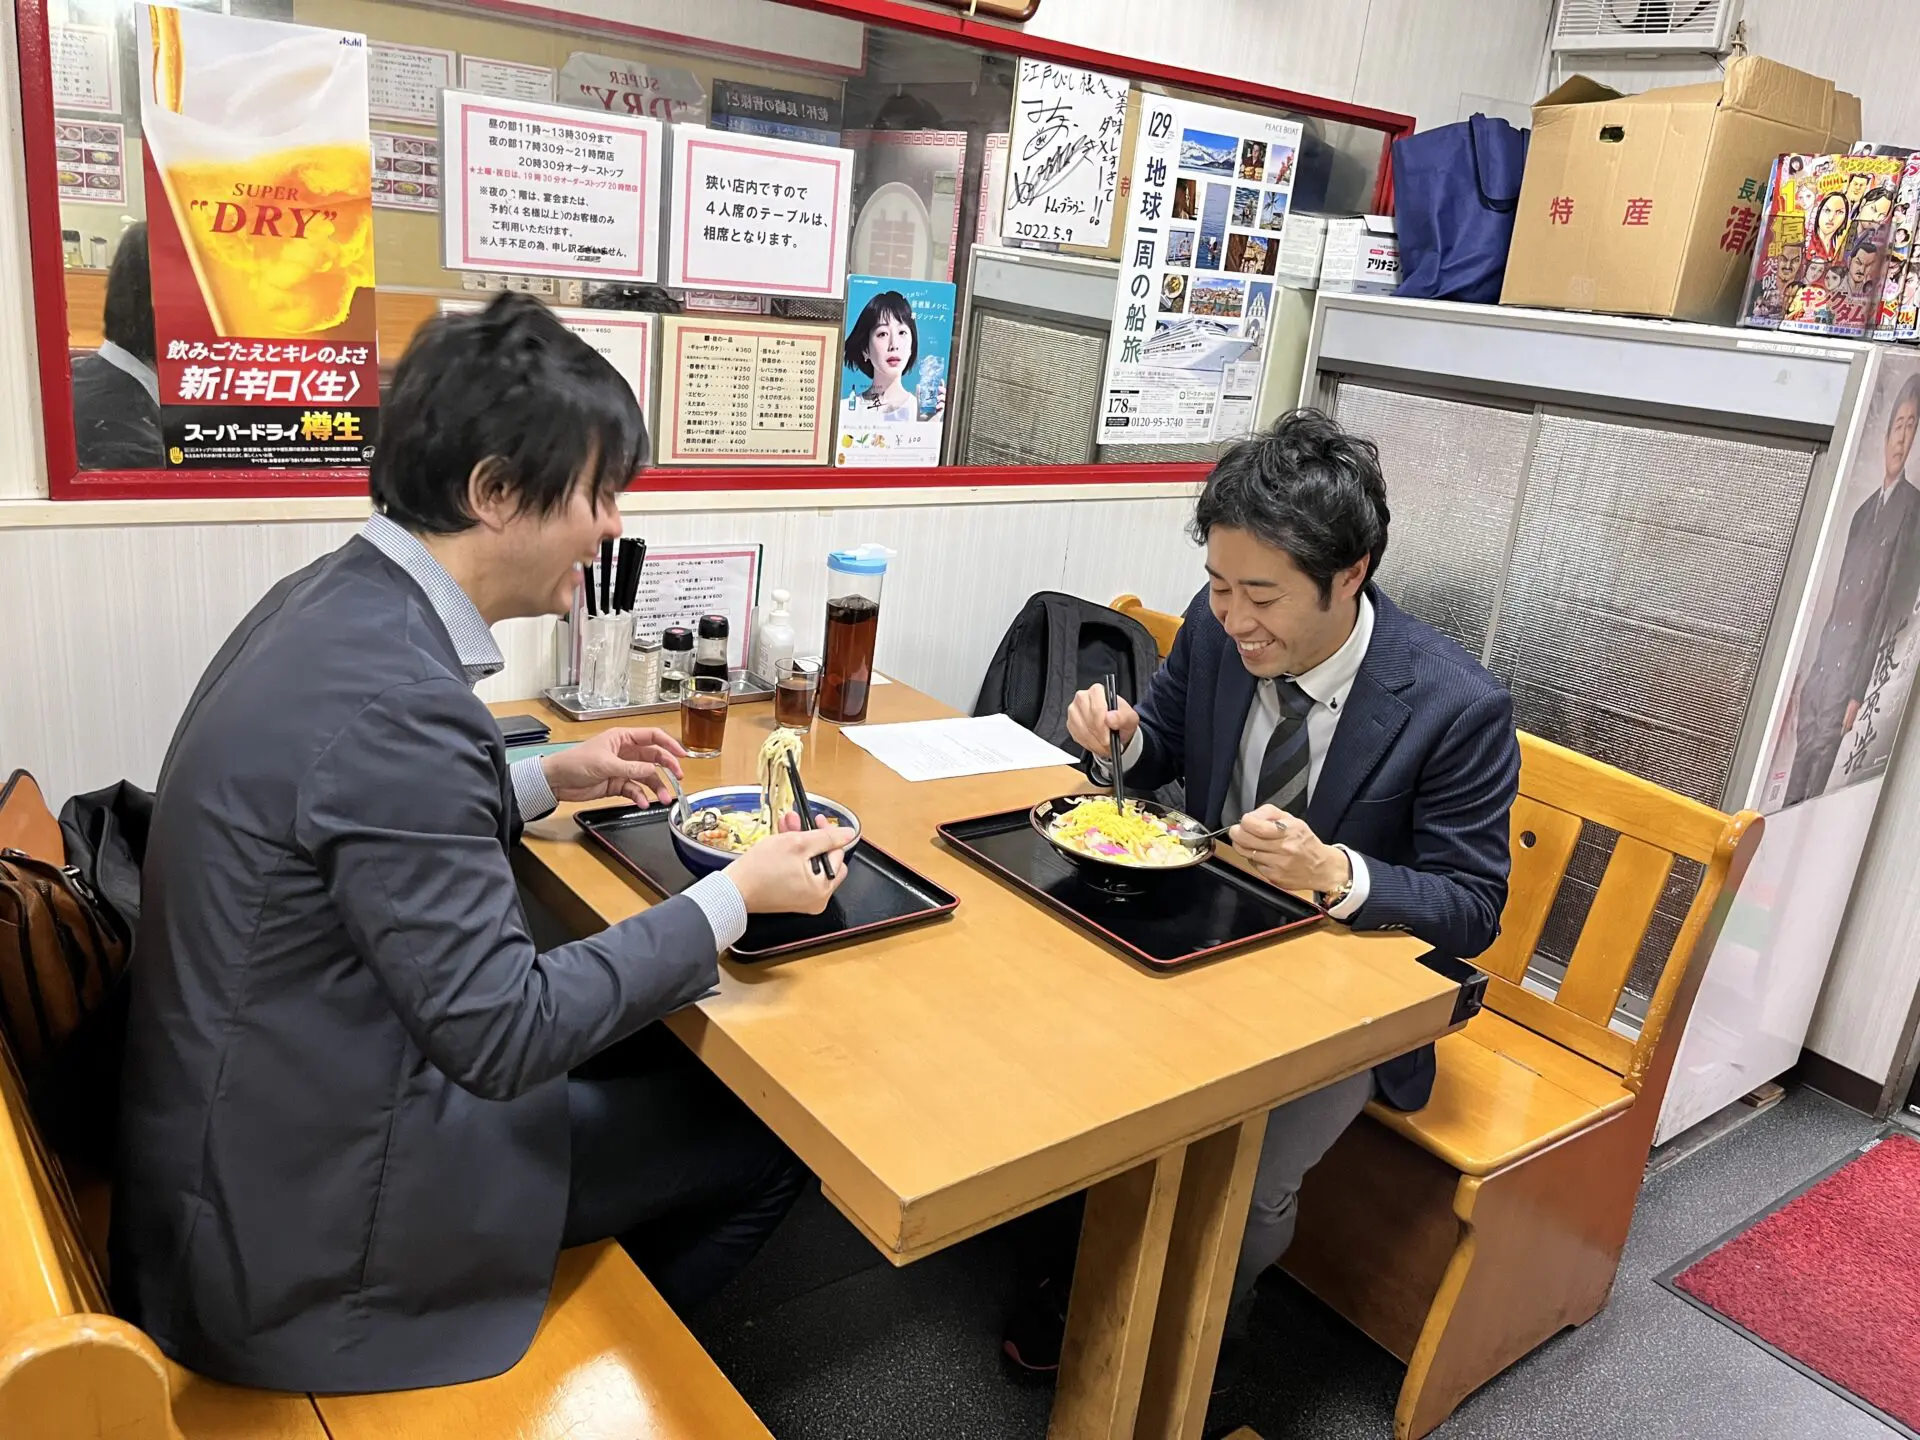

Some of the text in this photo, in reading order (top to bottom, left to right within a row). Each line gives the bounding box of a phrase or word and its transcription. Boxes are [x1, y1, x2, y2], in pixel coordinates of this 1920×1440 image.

[1148, 111, 1172, 138] 129
[518, 156, 624, 178] 20時30分オーダーストップ
[231, 182, 300, 202] SUPER
[705, 174, 808, 201] 狭い店内ですので
[705, 200, 829, 228] 4人席のテーブルは、
[1549, 195, 1654, 228] 特 産
[492, 220, 574, 238] ご利用いただけます。
[703, 225, 798, 249] 相席となります。
[1015, 221, 1074, 242] 2022.5.9
[1119, 156, 1167, 365] 地球一周の船旅
[1366, 257, 1400, 273] アリナミン
[166, 339, 369, 366] 飲みごたえとキレのよさ
[1107, 398, 1129, 414] 178
[184, 410, 364, 442] スーパードライ 樽生
[1131, 417, 1184, 428] 0120-95-3740
